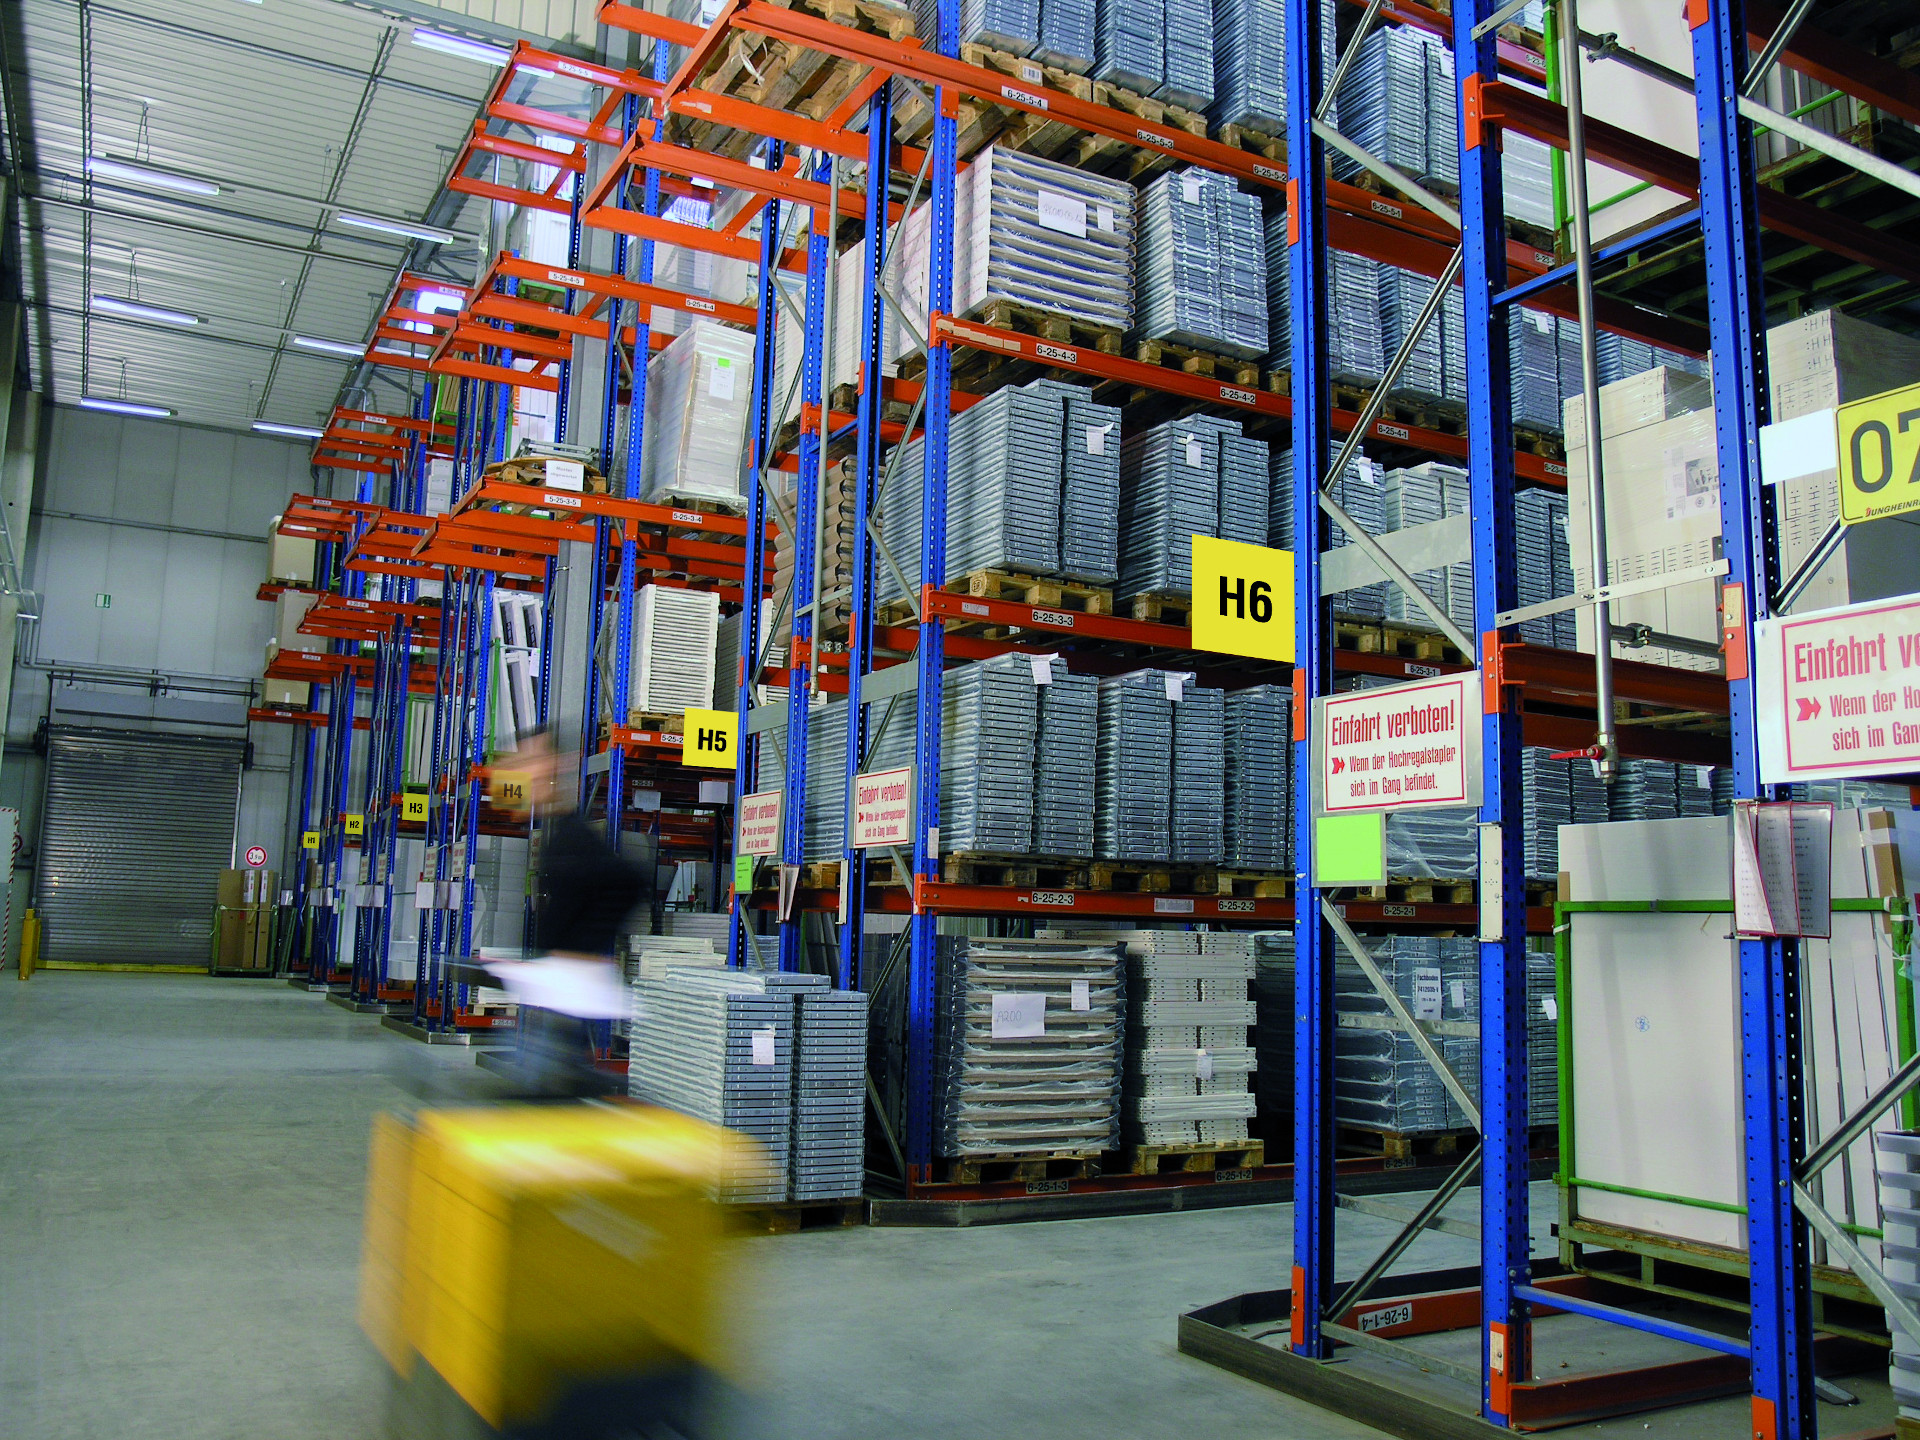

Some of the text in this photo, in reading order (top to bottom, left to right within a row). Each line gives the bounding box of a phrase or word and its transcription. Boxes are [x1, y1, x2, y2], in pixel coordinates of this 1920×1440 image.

[563, 64, 588, 77] 5-25-5-5
[1007, 89, 1042, 108] 6-25-5-4
[1137, 131, 1173, 150] 6-25-5-3
[1253, 166, 1286, 183] 6-25-5-2
[1371, 201, 1401, 218] 6-25-5-1
[553, 273, 580, 284] 5-25-4-5
[686, 299, 714, 311] 5-25-4-4
[1037, 345, 1076, 363] 6-25-4-3
[1220, 388, 1255, 404] 6-25-4-2
[1378, 424, 1407, 438] 6-25-4-1
[549, 496, 577, 506] 5-25-3-5
[1866, 499, 1920, 517] JUNGHEINR
[673, 512, 702, 523] 5-25-3-4
[1219, 575, 1273, 623] H6
[1032, 611, 1073, 627] 6-25-3-3
[1794, 633, 1887, 683] Einfahrt
[1410, 664, 1437, 676] 6-25-3-1
[1829, 694, 1866, 718] Wenn
[1872, 690, 1896, 713] der
[1332, 699, 1454, 746] Einfahrt verboten!
[698, 728, 727, 752] H5
[1832, 721, 1920, 751] sich im Gan
[1349, 745, 1455, 772] Wenn der Hochregalstapler
[503, 783, 523, 799] H4
[1350, 772, 1438, 797] sich im Gang befindet.
[409, 803, 423, 814] H3
[349, 821, 360, 829] H2
[1032, 892, 1074, 905] 6-25-2-3
[1218, 901, 1255, 911] 6-25-2-2
[1384, 906, 1414, 916] 6-25-2-1
[1216, 1169, 1251, 1181] 6-25-1-2
[1027, 1181, 1067, 1193] 6-25-1-3
[1361, 1307, 1409, 1331] 6-26-1-4
